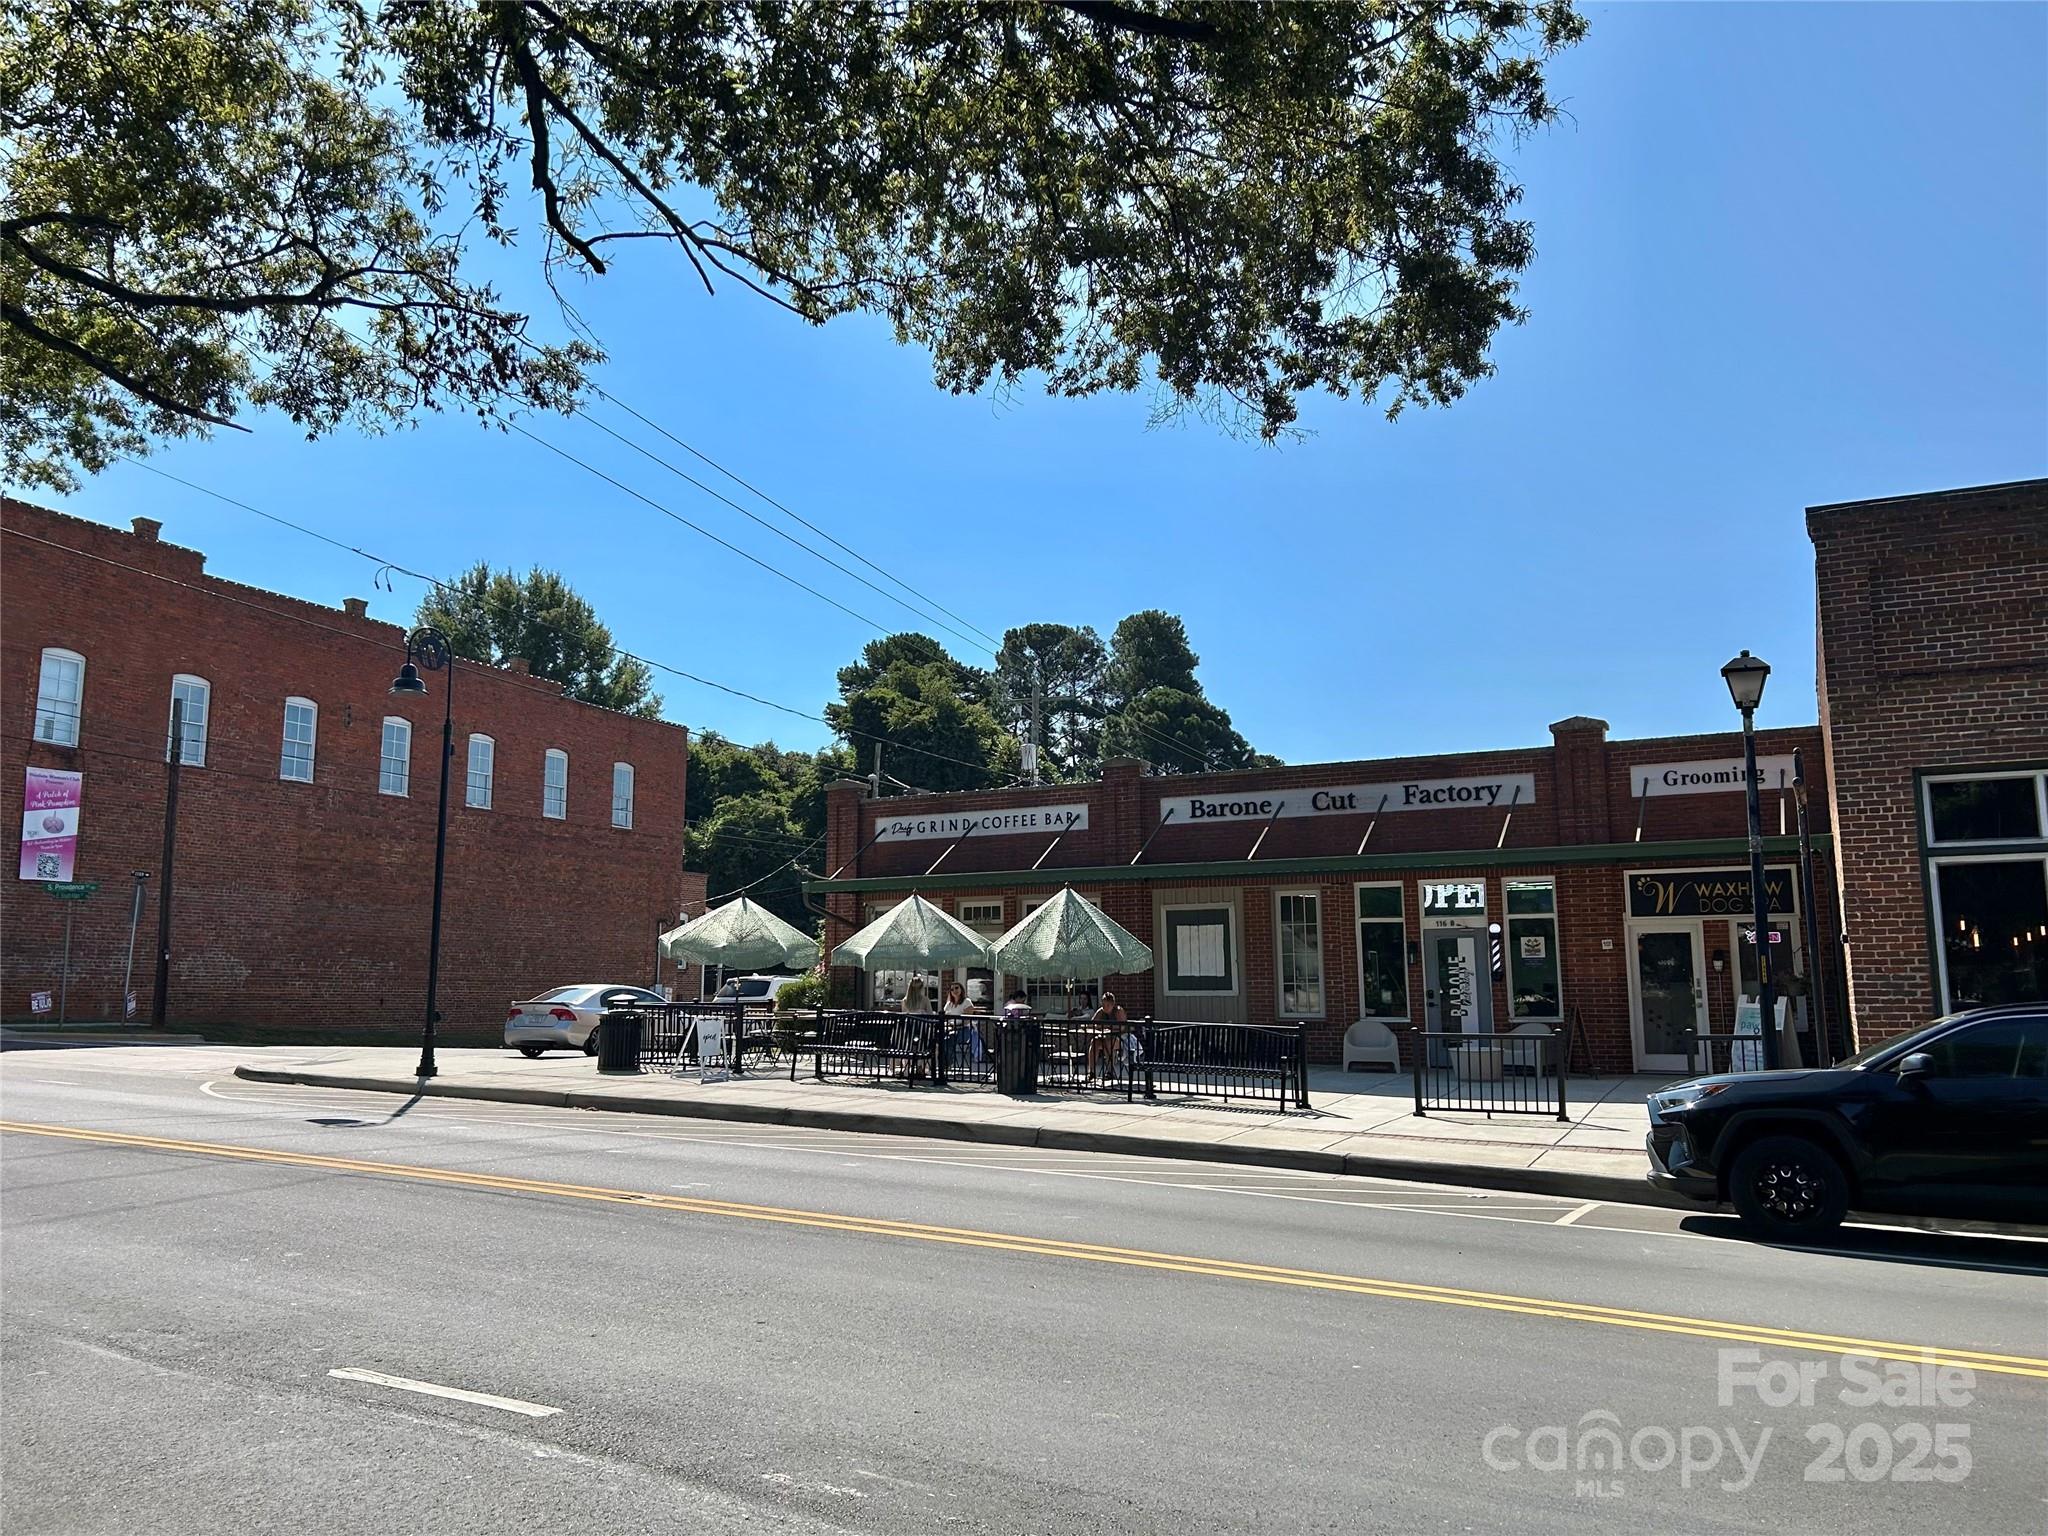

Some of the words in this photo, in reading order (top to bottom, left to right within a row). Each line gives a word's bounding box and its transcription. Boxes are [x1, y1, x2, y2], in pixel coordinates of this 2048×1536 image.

[1189, 797, 1273, 819] Barone
[1311, 790, 1357, 811] Cut
[1402, 784, 1502, 806] Factory
[917, 818, 971, 833] GRIND
[981, 813, 1037, 829] COFFEE
[1044, 811, 1073, 825] BAR
[1643, 881, 1692, 914] W
[1694, 880, 1784, 897] WAXHW
[1700, 898, 1745, 913] DOG
[1447, 956, 1469, 1017] BARONE
